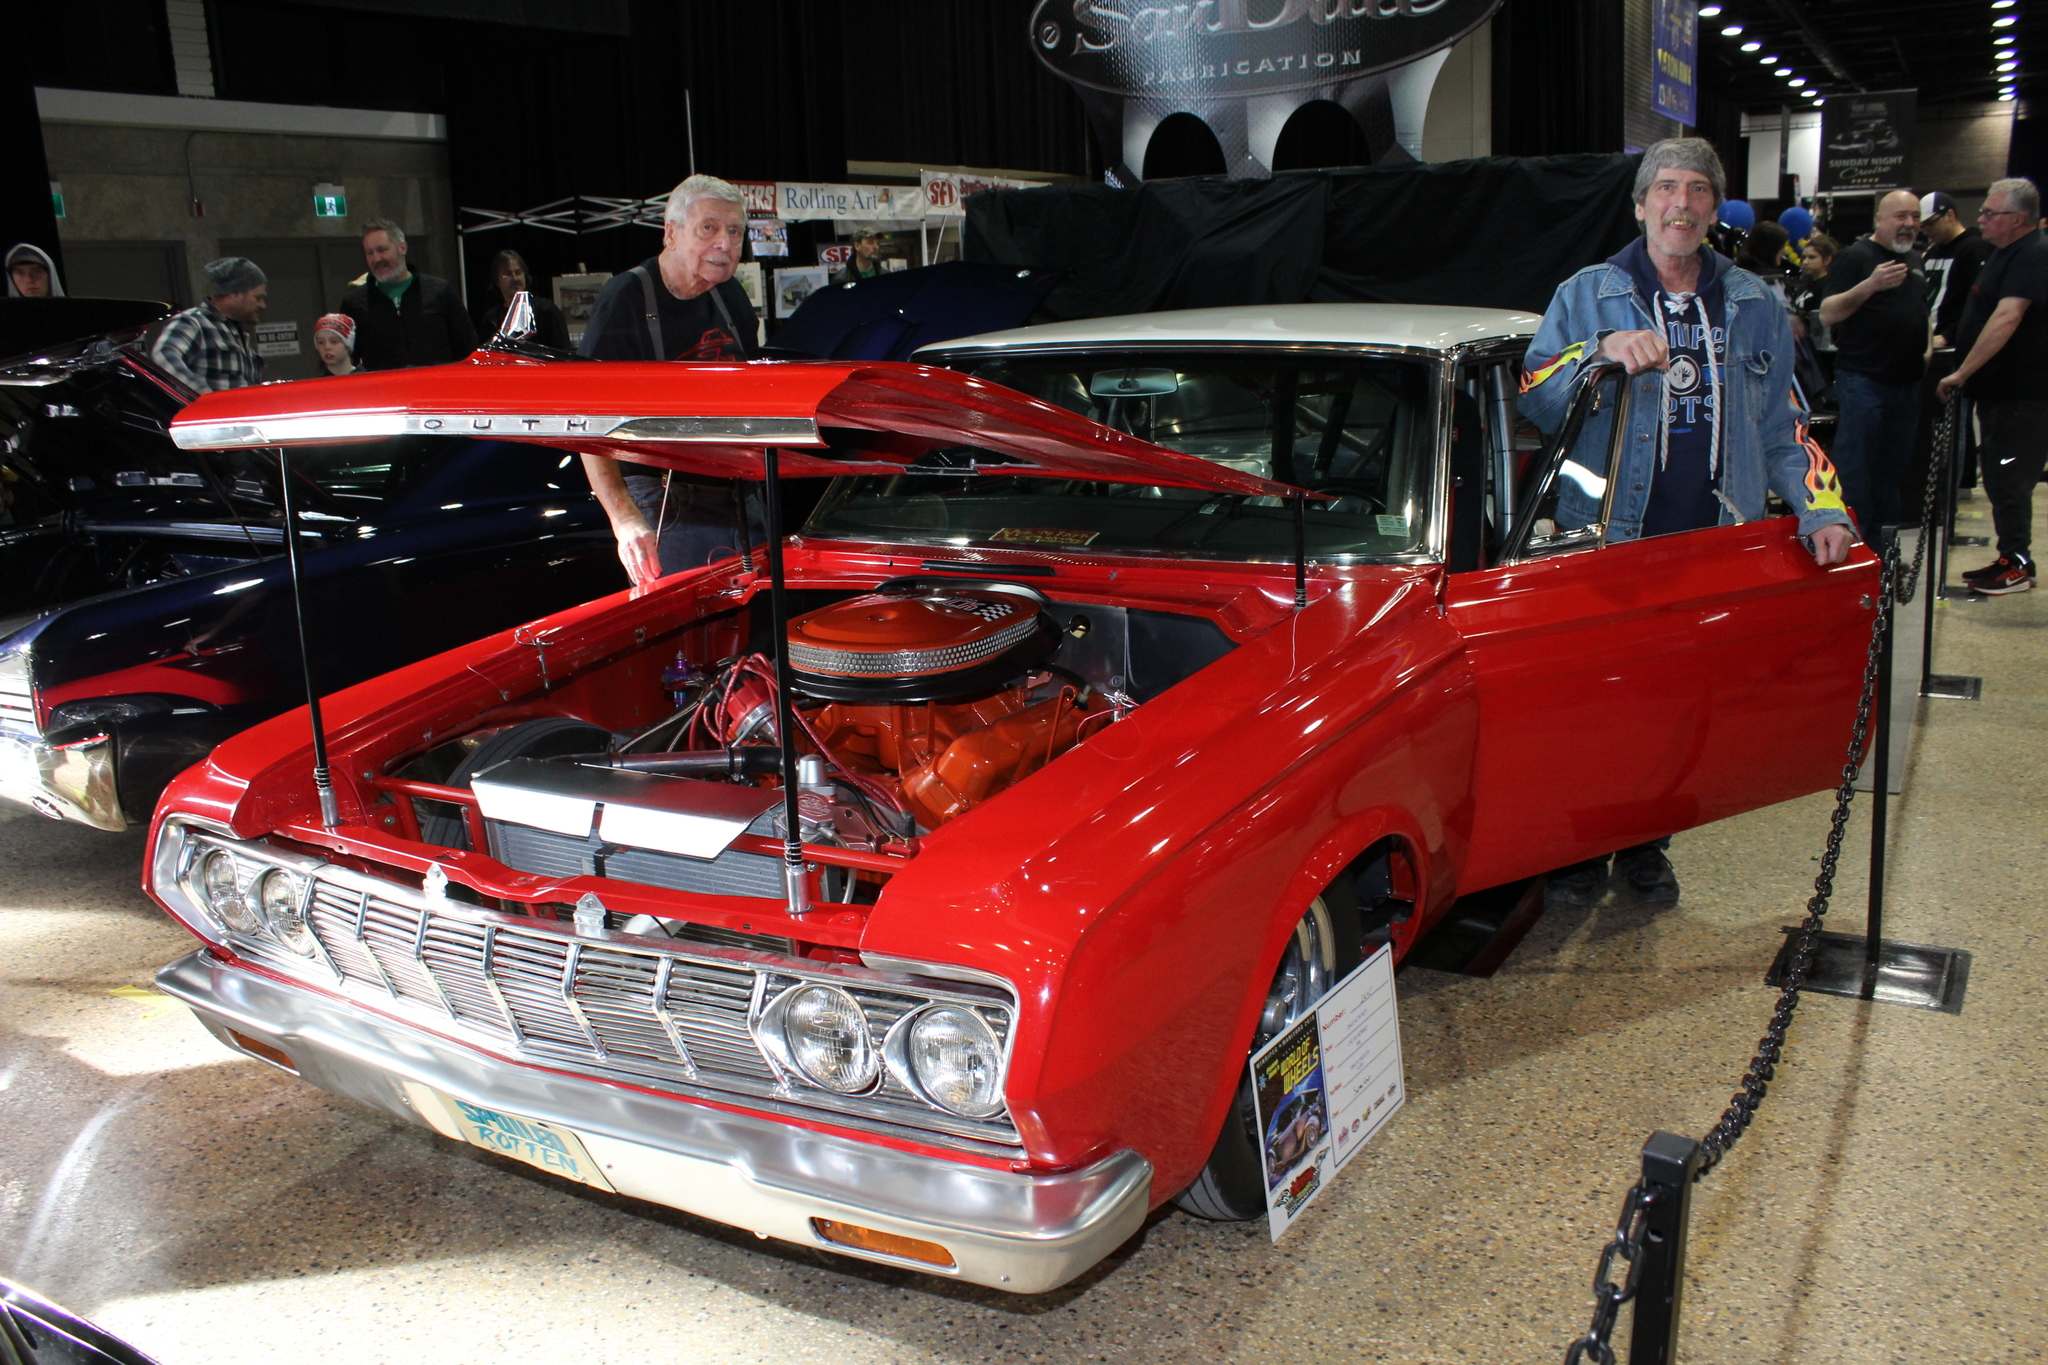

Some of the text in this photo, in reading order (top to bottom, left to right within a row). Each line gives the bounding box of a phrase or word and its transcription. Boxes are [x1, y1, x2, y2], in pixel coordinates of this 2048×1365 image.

[785, 187, 878, 215] Rolling Art
[1284, 1044, 1319, 1094] WHEELS
